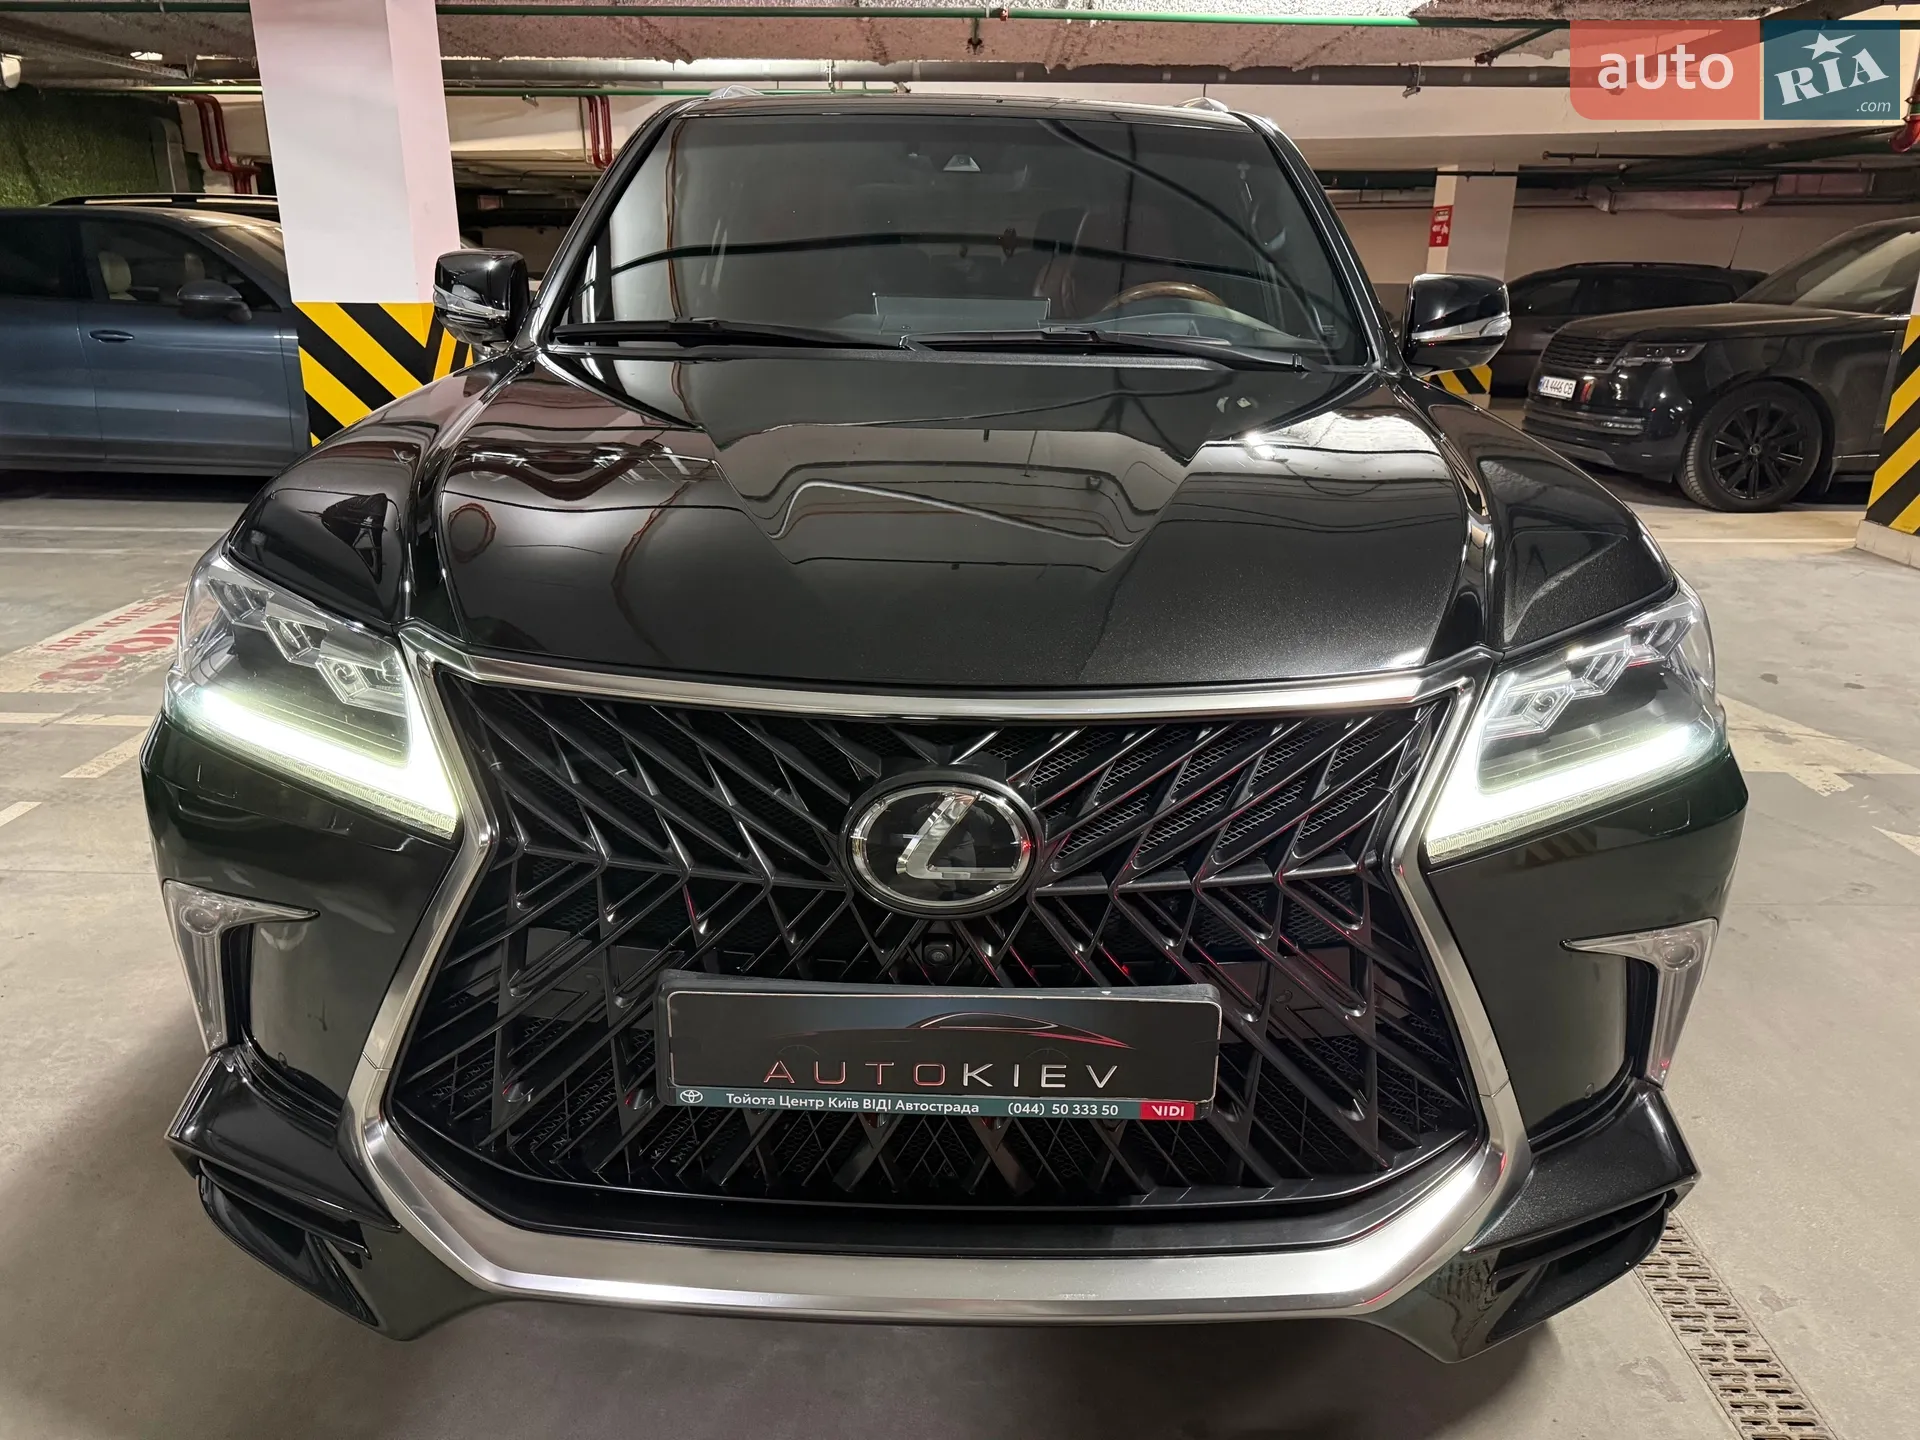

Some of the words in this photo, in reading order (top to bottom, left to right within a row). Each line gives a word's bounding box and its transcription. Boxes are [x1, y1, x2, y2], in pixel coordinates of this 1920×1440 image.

[764, 1060, 1118, 1088] AUTOKIEV
[726, 1092, 776, 1107] Тойота
[779, 1095, 825, 1110] Центр
[828, 1097, 859, 1109] Київ
[863, 1099, 891, 1111] ВІДІ
[895, 1099, 979, 1115] Автострада
[1008, 1103, 1045, 1115] (044)
[1052, 1104, 1069, 1115] 50
[1072, 1105, 1098, 1115] 333
[1101, 1105, 1119, 1116] 50
[1151, 1106, 1185, 1117] VIDI
